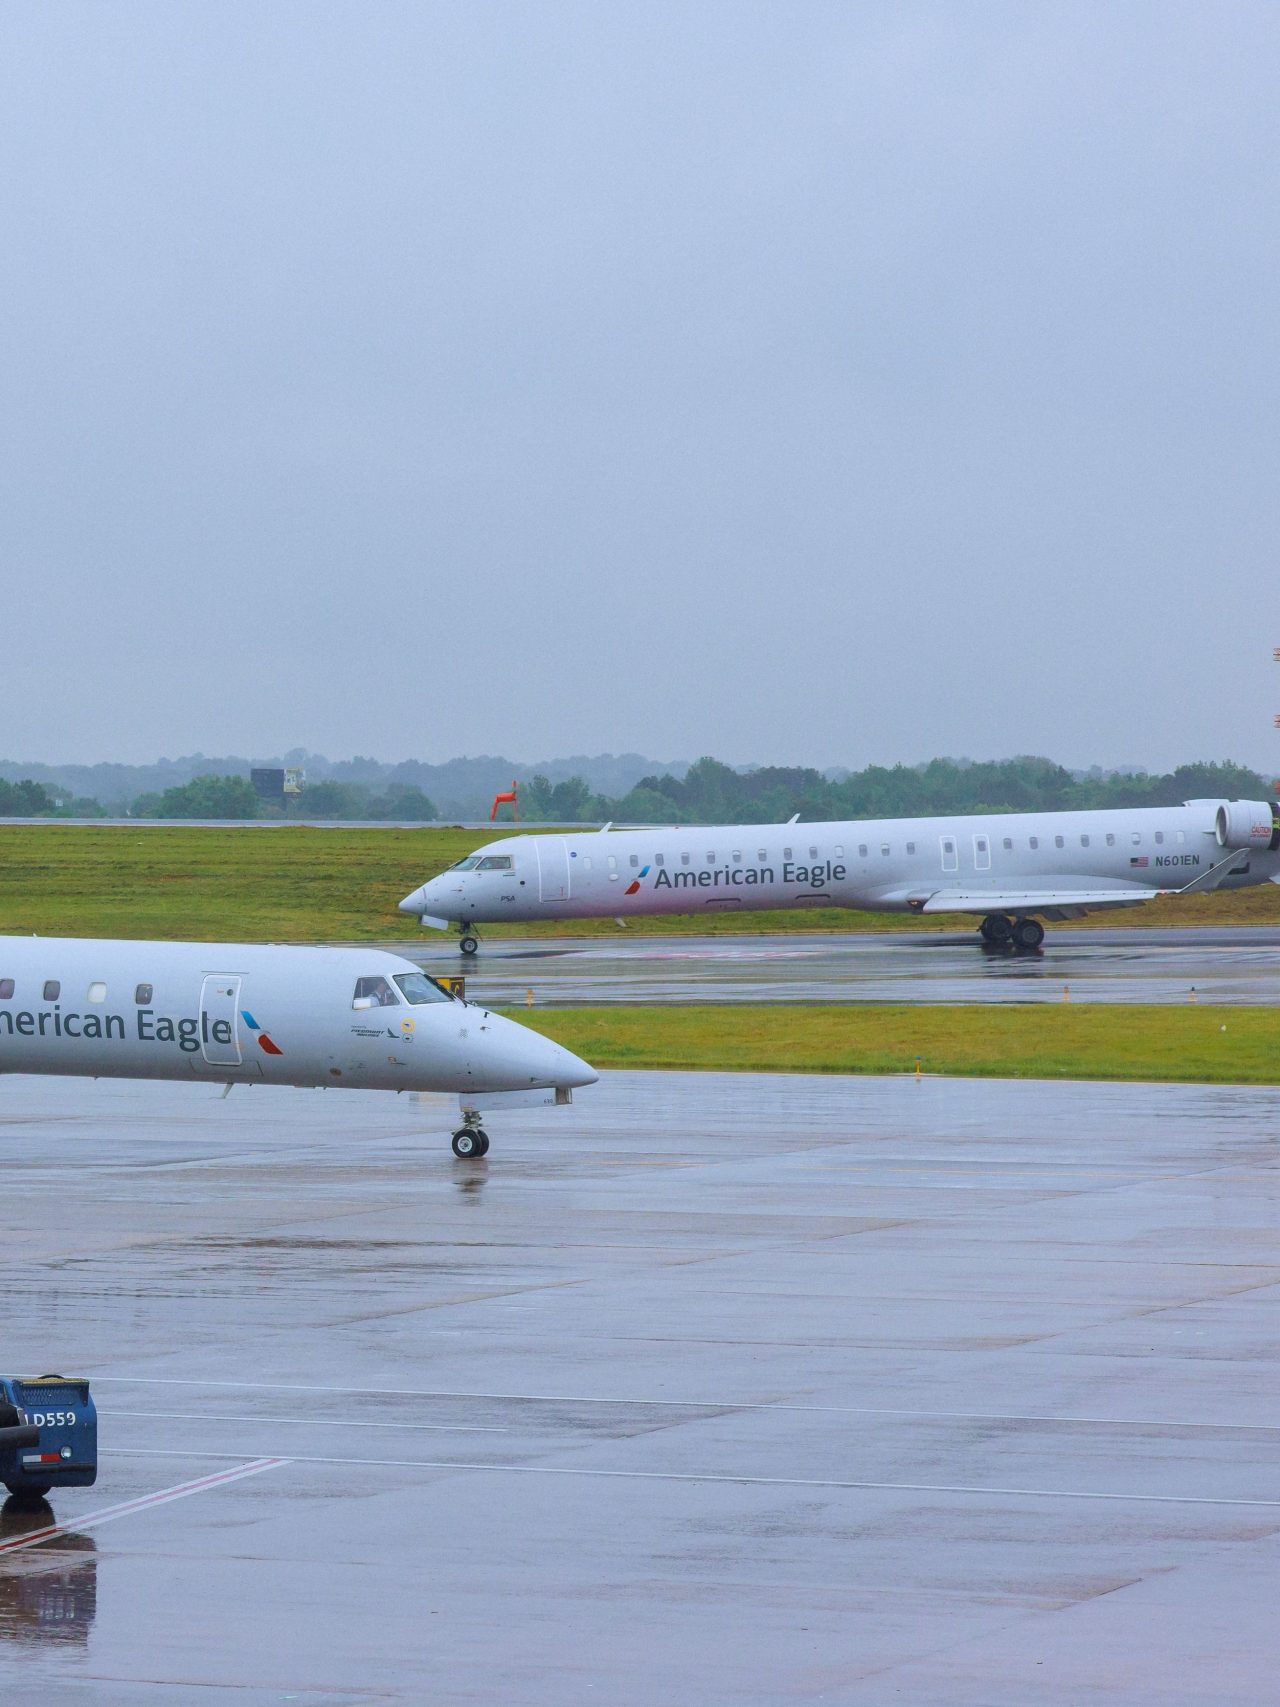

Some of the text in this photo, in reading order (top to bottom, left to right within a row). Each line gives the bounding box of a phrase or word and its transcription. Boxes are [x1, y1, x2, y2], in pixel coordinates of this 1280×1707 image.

[654, 860, 847, 890] American Eagle
[1155, 854, 1200, 867] N601EN
[137, 1009, 233, 1053] Eagle
